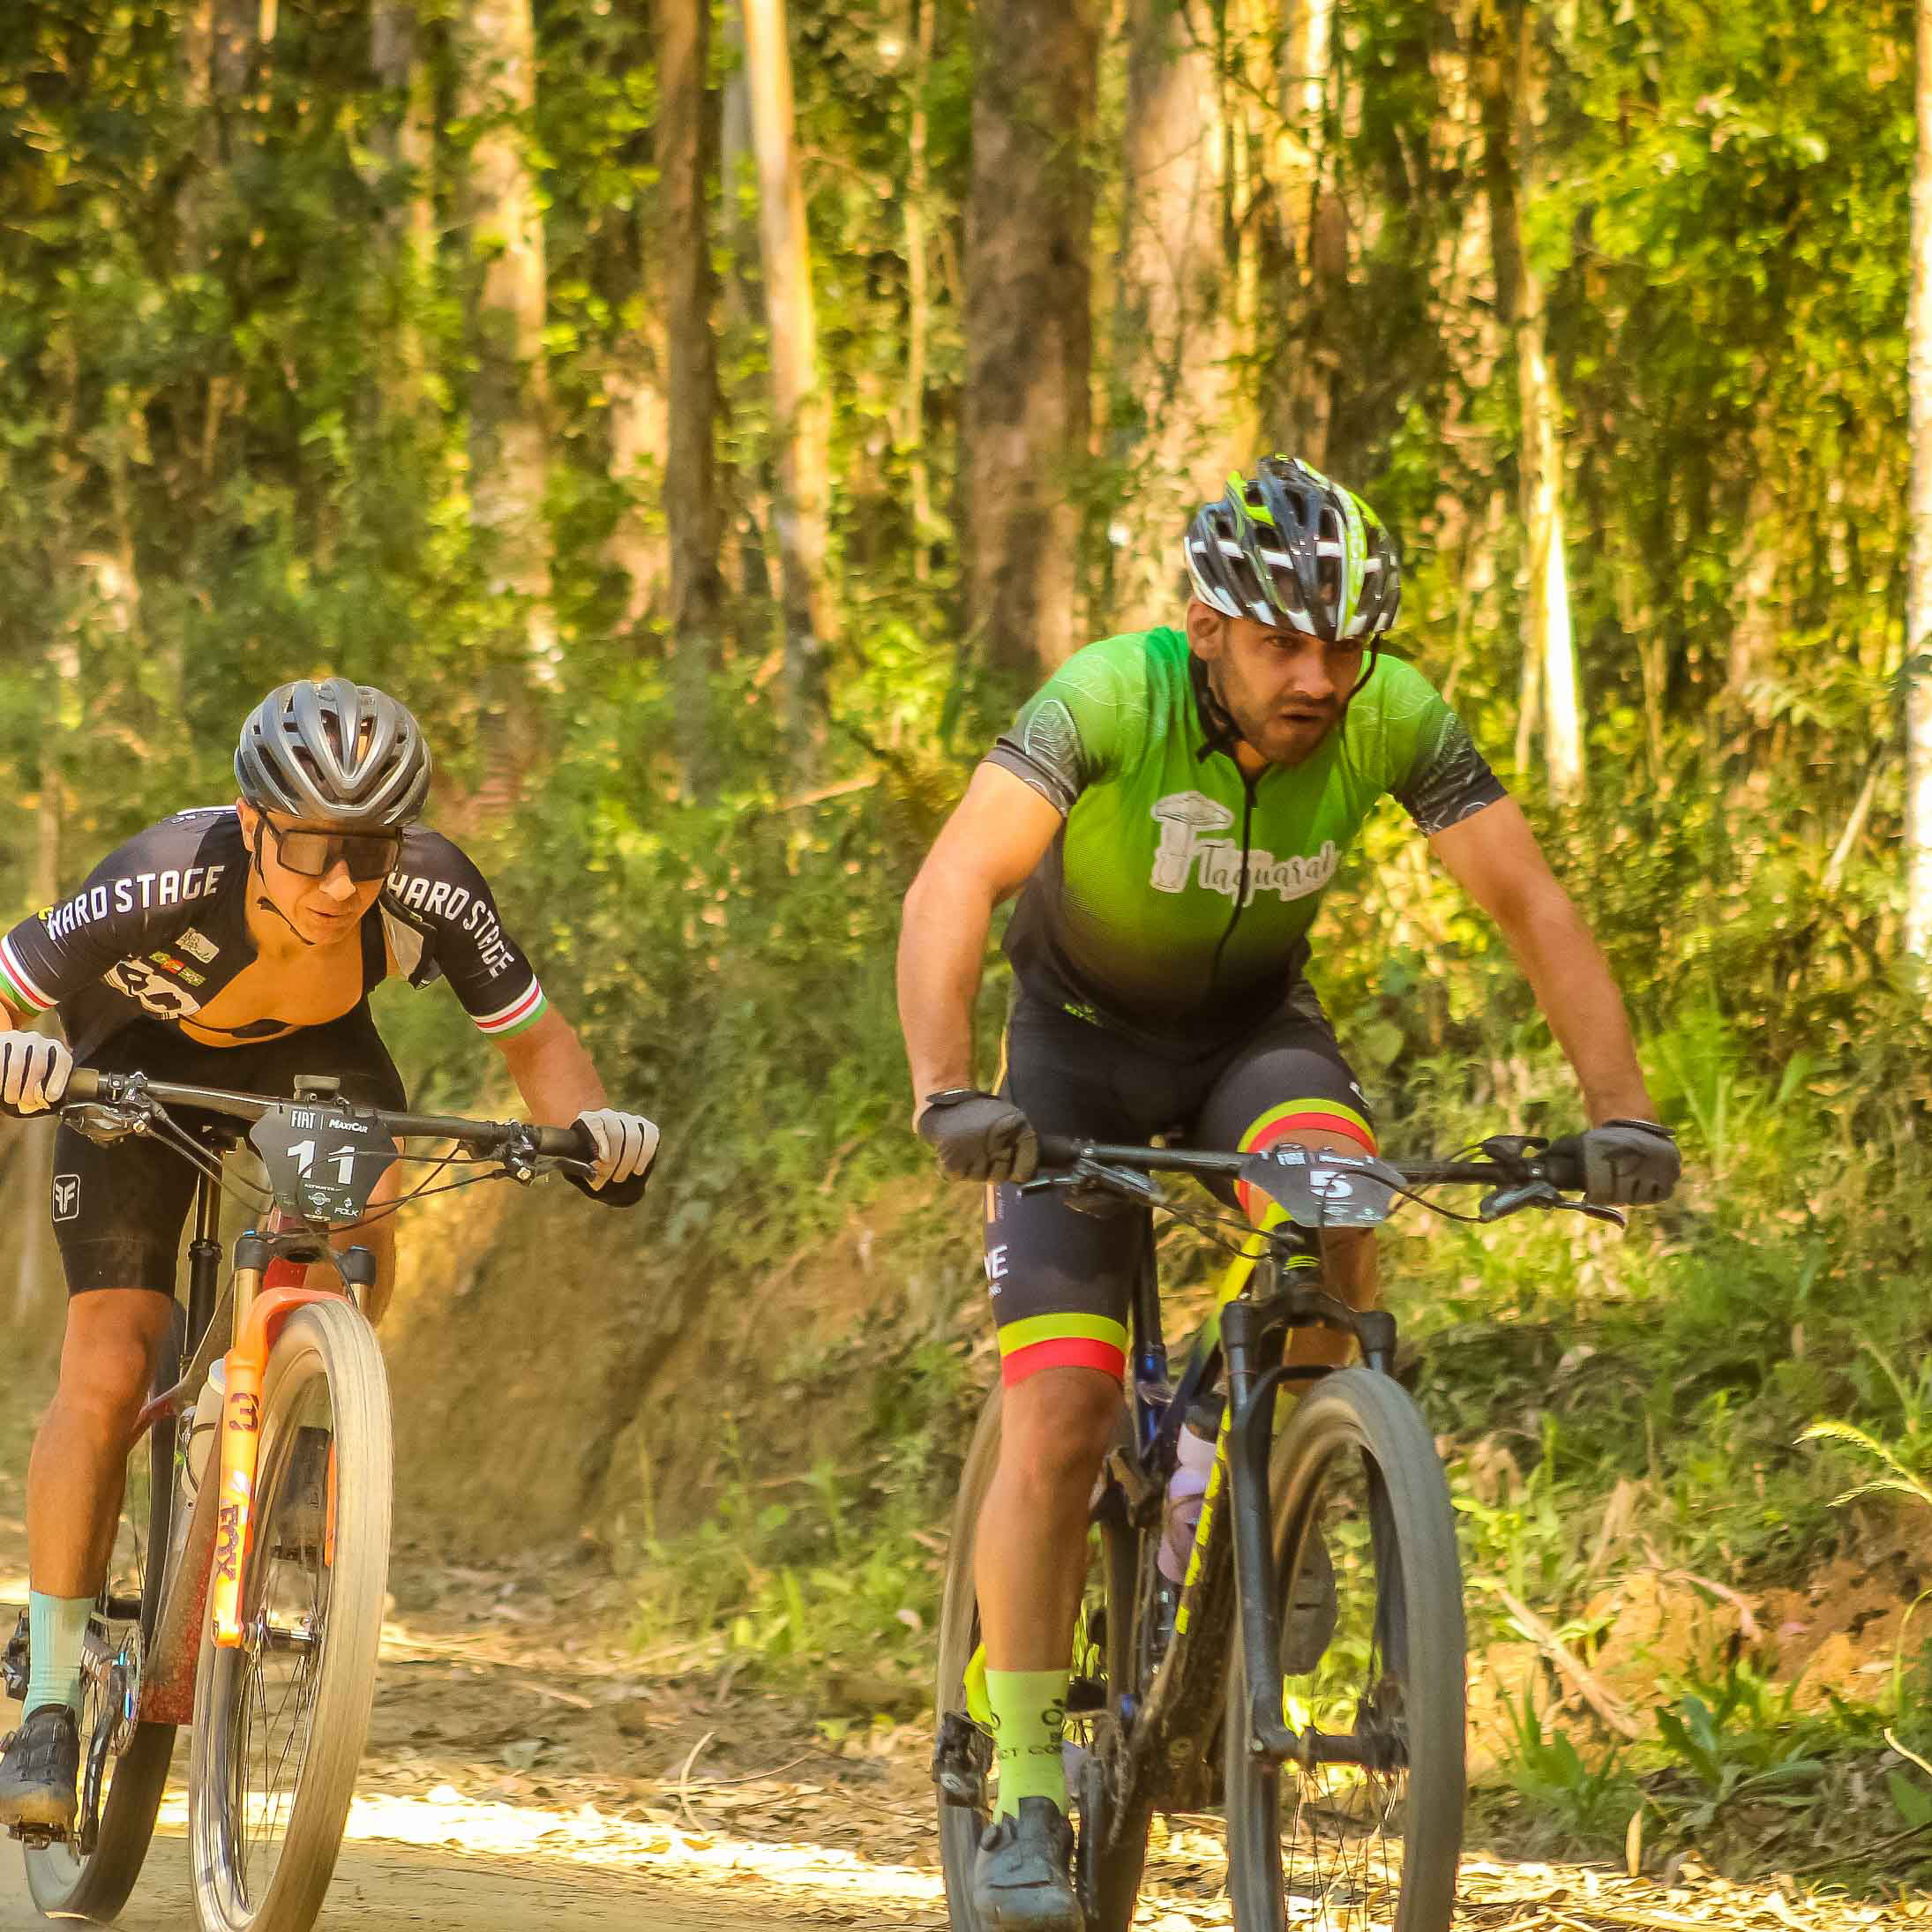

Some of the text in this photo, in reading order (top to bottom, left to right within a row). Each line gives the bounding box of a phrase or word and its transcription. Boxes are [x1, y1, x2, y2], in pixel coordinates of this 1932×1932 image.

[47, 865, 225, 941] HARD STAGE
[386, 872, 515, 979] HARD STAGE
[290, 1109, 316, 1130] FIAT
[287, 1139, 356, 1186] 11
[1309, 1170, 1354, 1200] 5
[217, 1503, 239, 1582] FOX
